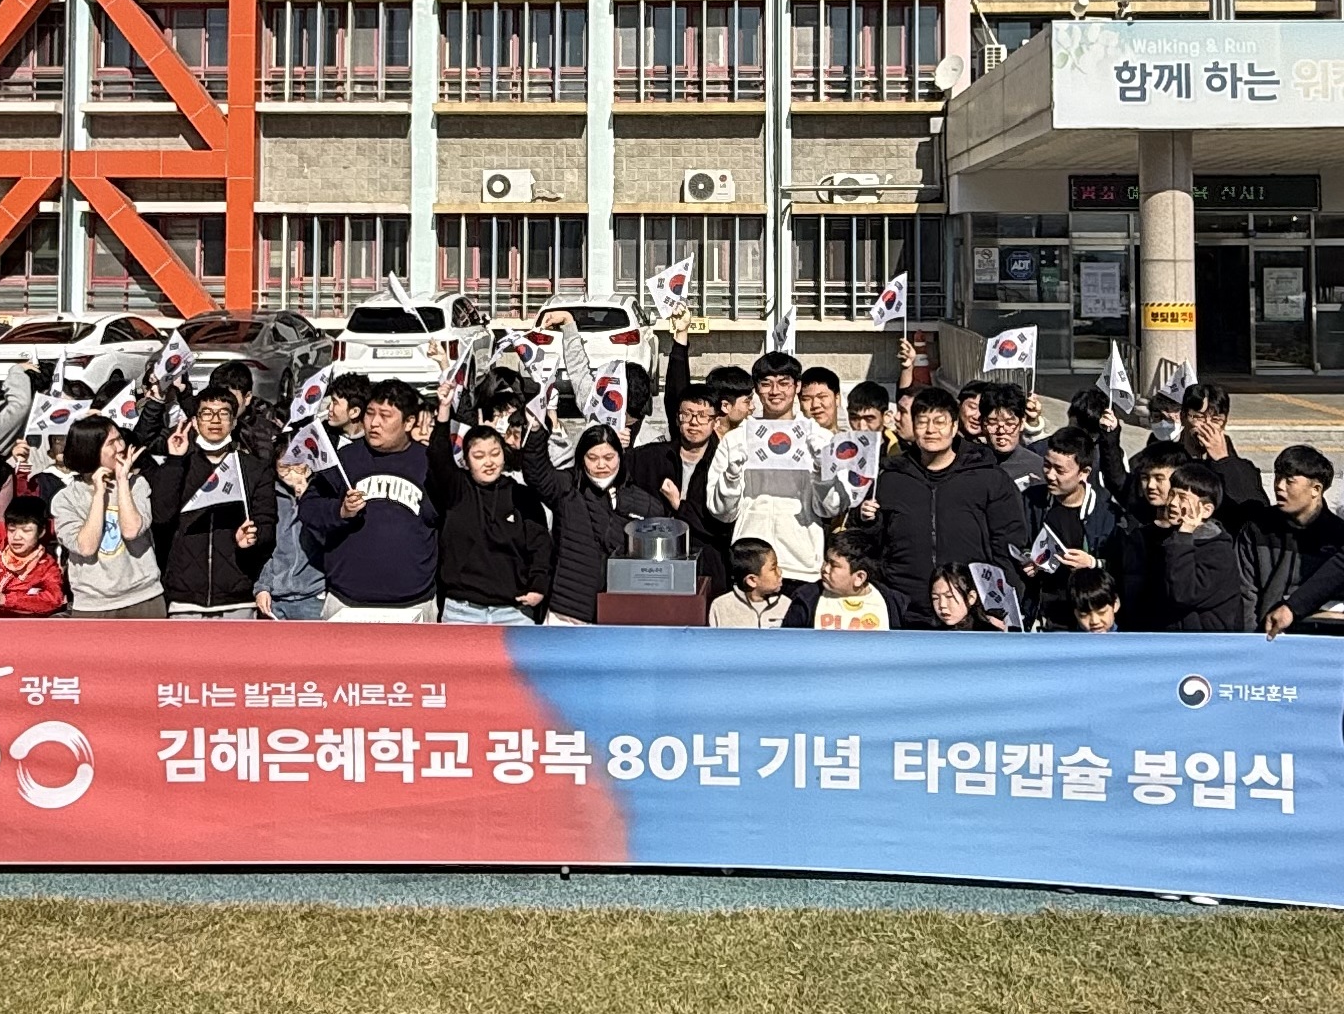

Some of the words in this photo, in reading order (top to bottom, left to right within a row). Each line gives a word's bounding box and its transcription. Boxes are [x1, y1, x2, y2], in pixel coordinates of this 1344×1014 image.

[1132, 38, 1200, 57] Walking
[1225, 39, 1257, 53] Run
[1114, 60, 1192, 102] 함께
[1203, 61, 1281, 102] 하는
[1011, 260, 1031, 271] ADT
[19, 675, 81, 706] 광복
[157, 682, 238, 709] 빛나는
[244, 681, 330, 709] 발걸음,
[333, 681, 414, 708] 새로운
[420, 682, 447, 709] 길
[1218, 683, 1299, 704] 국가보훈부
[156, 726, 474, 785] 김해은혜학교
[485, 728, 593, 786] 광복
[606, 731, 743, 789] 80년
[756, 732, 862, 792] 기념
[893, 738, 1113, 803] 타임캡슐
[1127, 749, 1297, 815] 봉입식
